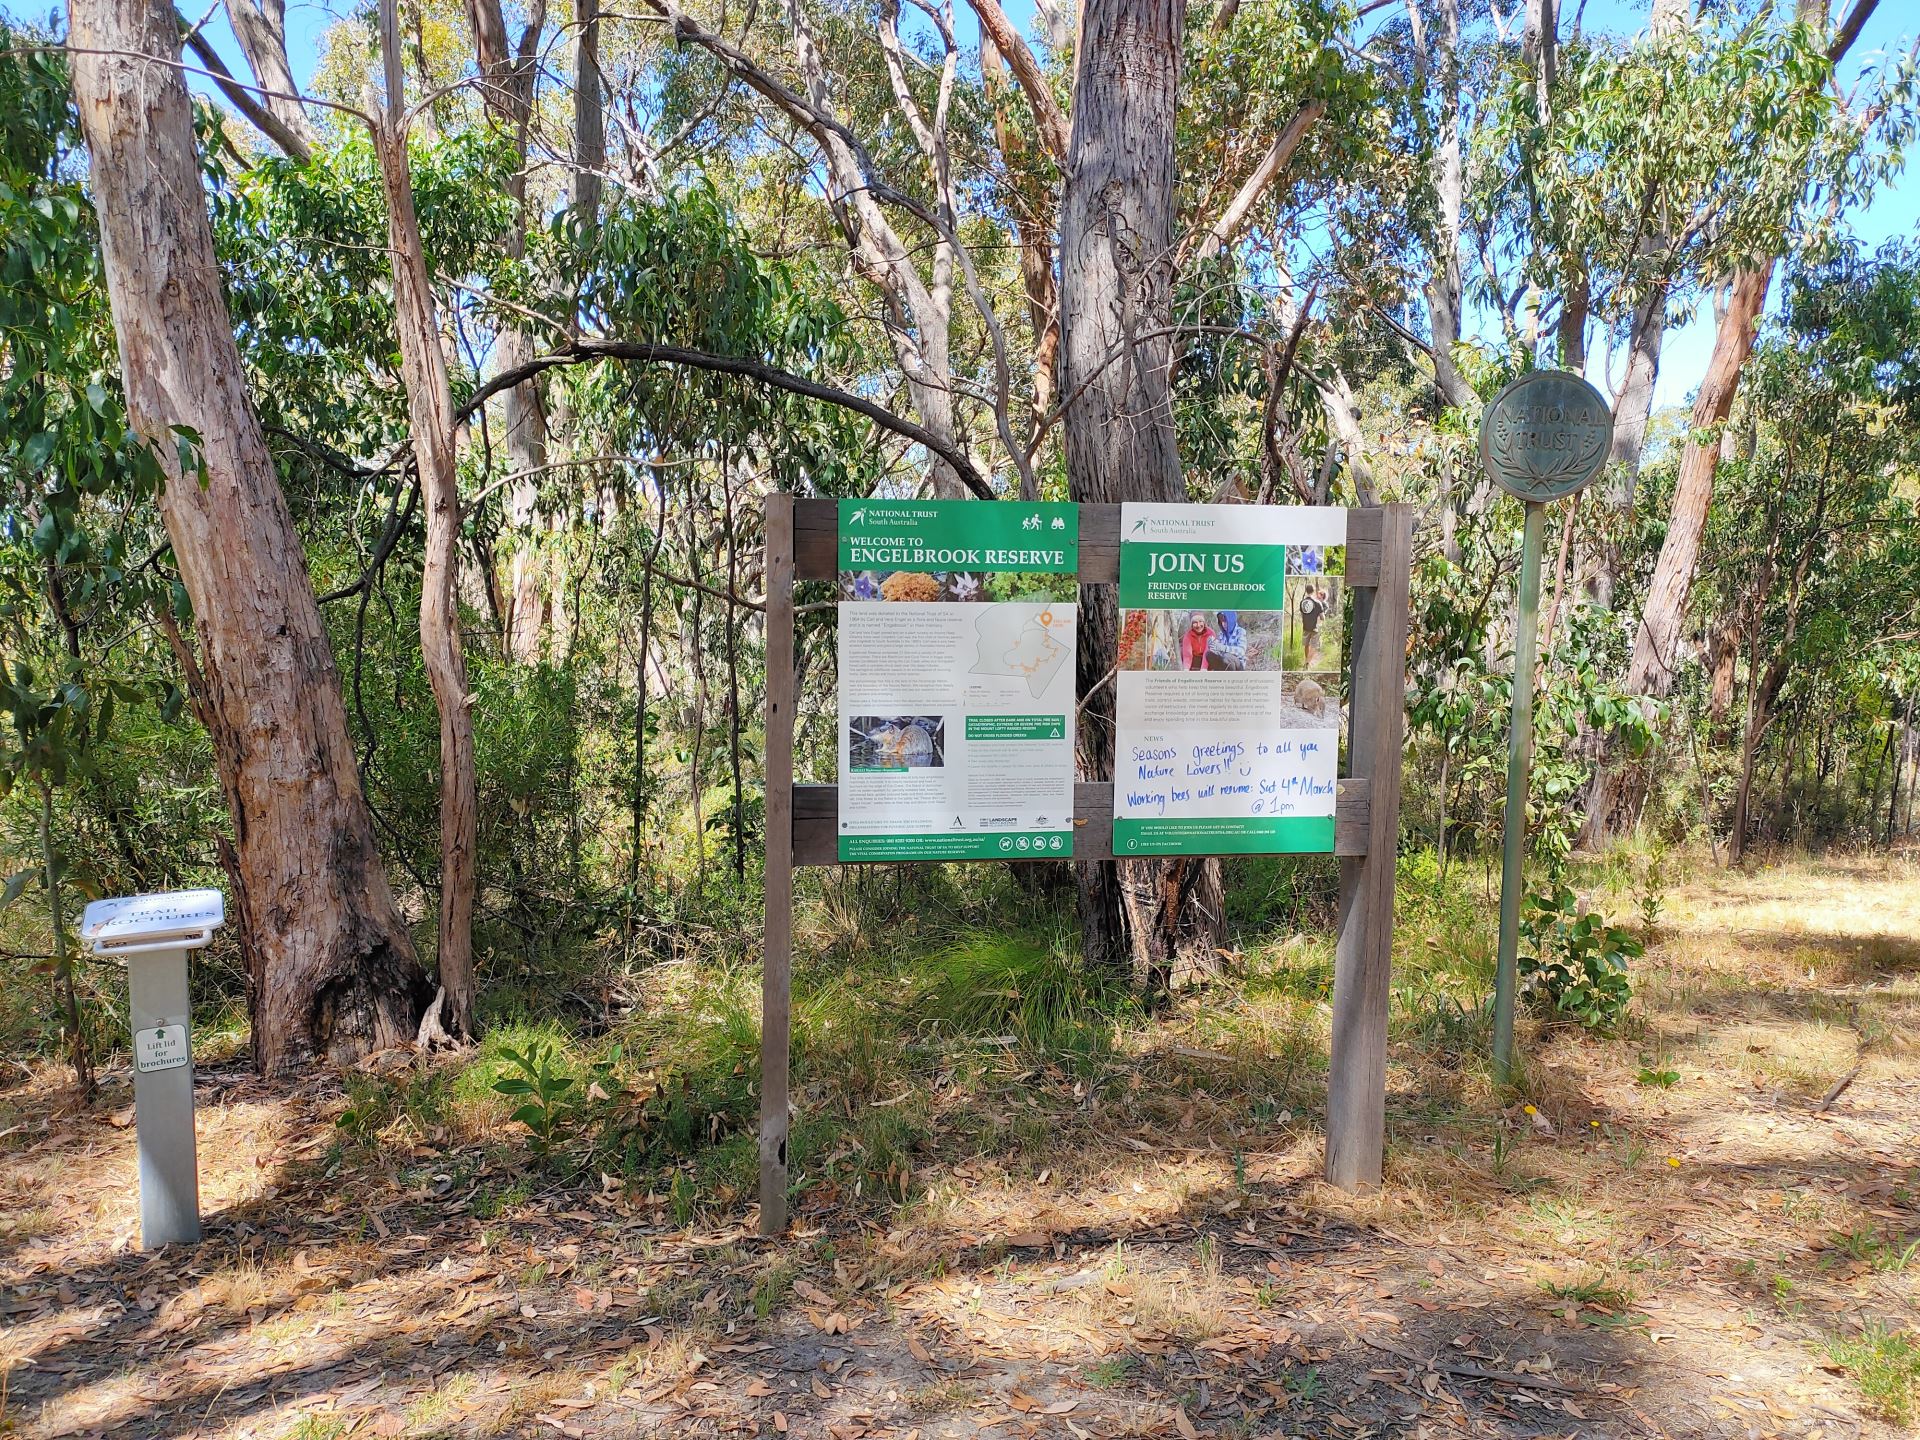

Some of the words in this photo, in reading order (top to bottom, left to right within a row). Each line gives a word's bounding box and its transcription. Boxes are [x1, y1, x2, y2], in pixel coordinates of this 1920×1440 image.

[1498, 405, 1605, 427] NATIONAL
[1516, 430, 1578, 452] TRUST
[868, 509, 912, 518] NATIONAL
[912, 510, 938, 518] TRUST
[868, 518, 887, 526] South
[888, 518, 918, 526] Australia
[1150, 519, 1190, 527] NATIONAL
[1150, 526, 1168, 534] South
[850, 536, 906, 546] WELCOME
[907, 537, 924, 546] TO
[850, 548, 980, 564] ENGELBROOK
[985, 550, 1064, 565] RESERVE
[1148, 552, 1206, 576] JOIN
[1212, 554, 1245, 573] US
[1148, 582, 1188, 591] FRIENDS
[1189, 582, 1202, 591] OF
[1203, 583, 1266, 592] ENGELBROOK
[1148, 592, 1188, 600] RESERVE
[1132, 746, 1177, 762] Seasons
[1192, 741, 1245, 766] greetings
[1256, 742, 1268, 756] to
[1276, 741, 1291, 754] all
[1300, 743, 1319, 762] you
[1138, 765, 1175, 780] Nature
[1127, 790, 1165, 816] Working
[1172, 785, 1190, 802] bees
[1198, 784, 1215, 799] will
[1299, 777, 1334, 797] March
[1251, 799, 1264, 814] @
[1269, 797, 1295, 815] 1pm
[147, 1042, 162, 1050] Lift
[155, 1050, 168, 1058] for
[140, 1056, 186, 1069] brochures
